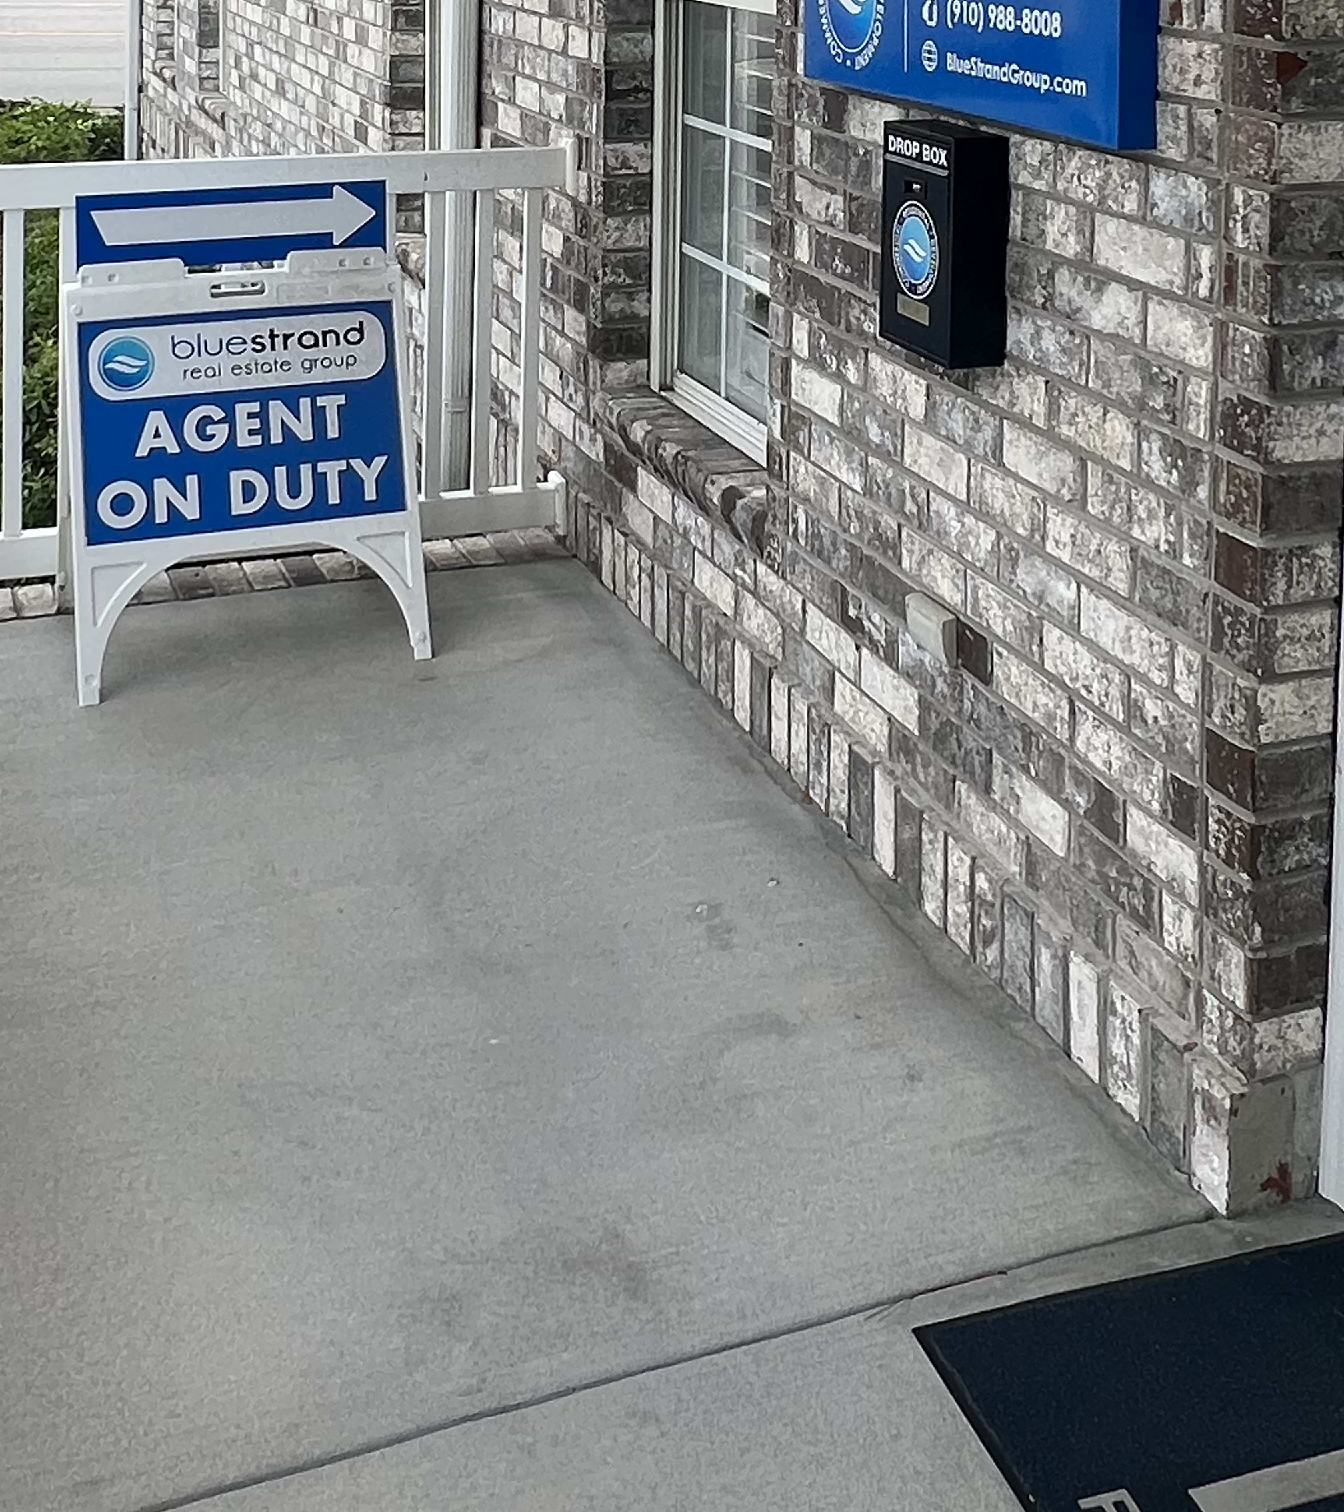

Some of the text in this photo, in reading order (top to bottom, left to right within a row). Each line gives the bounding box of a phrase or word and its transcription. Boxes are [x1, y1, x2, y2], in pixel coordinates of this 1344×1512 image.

[987, 4, 1062, 38] 988-8008
[946, 51, 1087, 97] BlueStrandGroup.com
[888, 134, 948, 167] DROP BOX
[170, 320, 366, 360] bluestrand
[182, 354, 358, 381] real estate group
[134, 394, 347, 458] AGENT
[96, 455, 388, 530] ON DUTY
